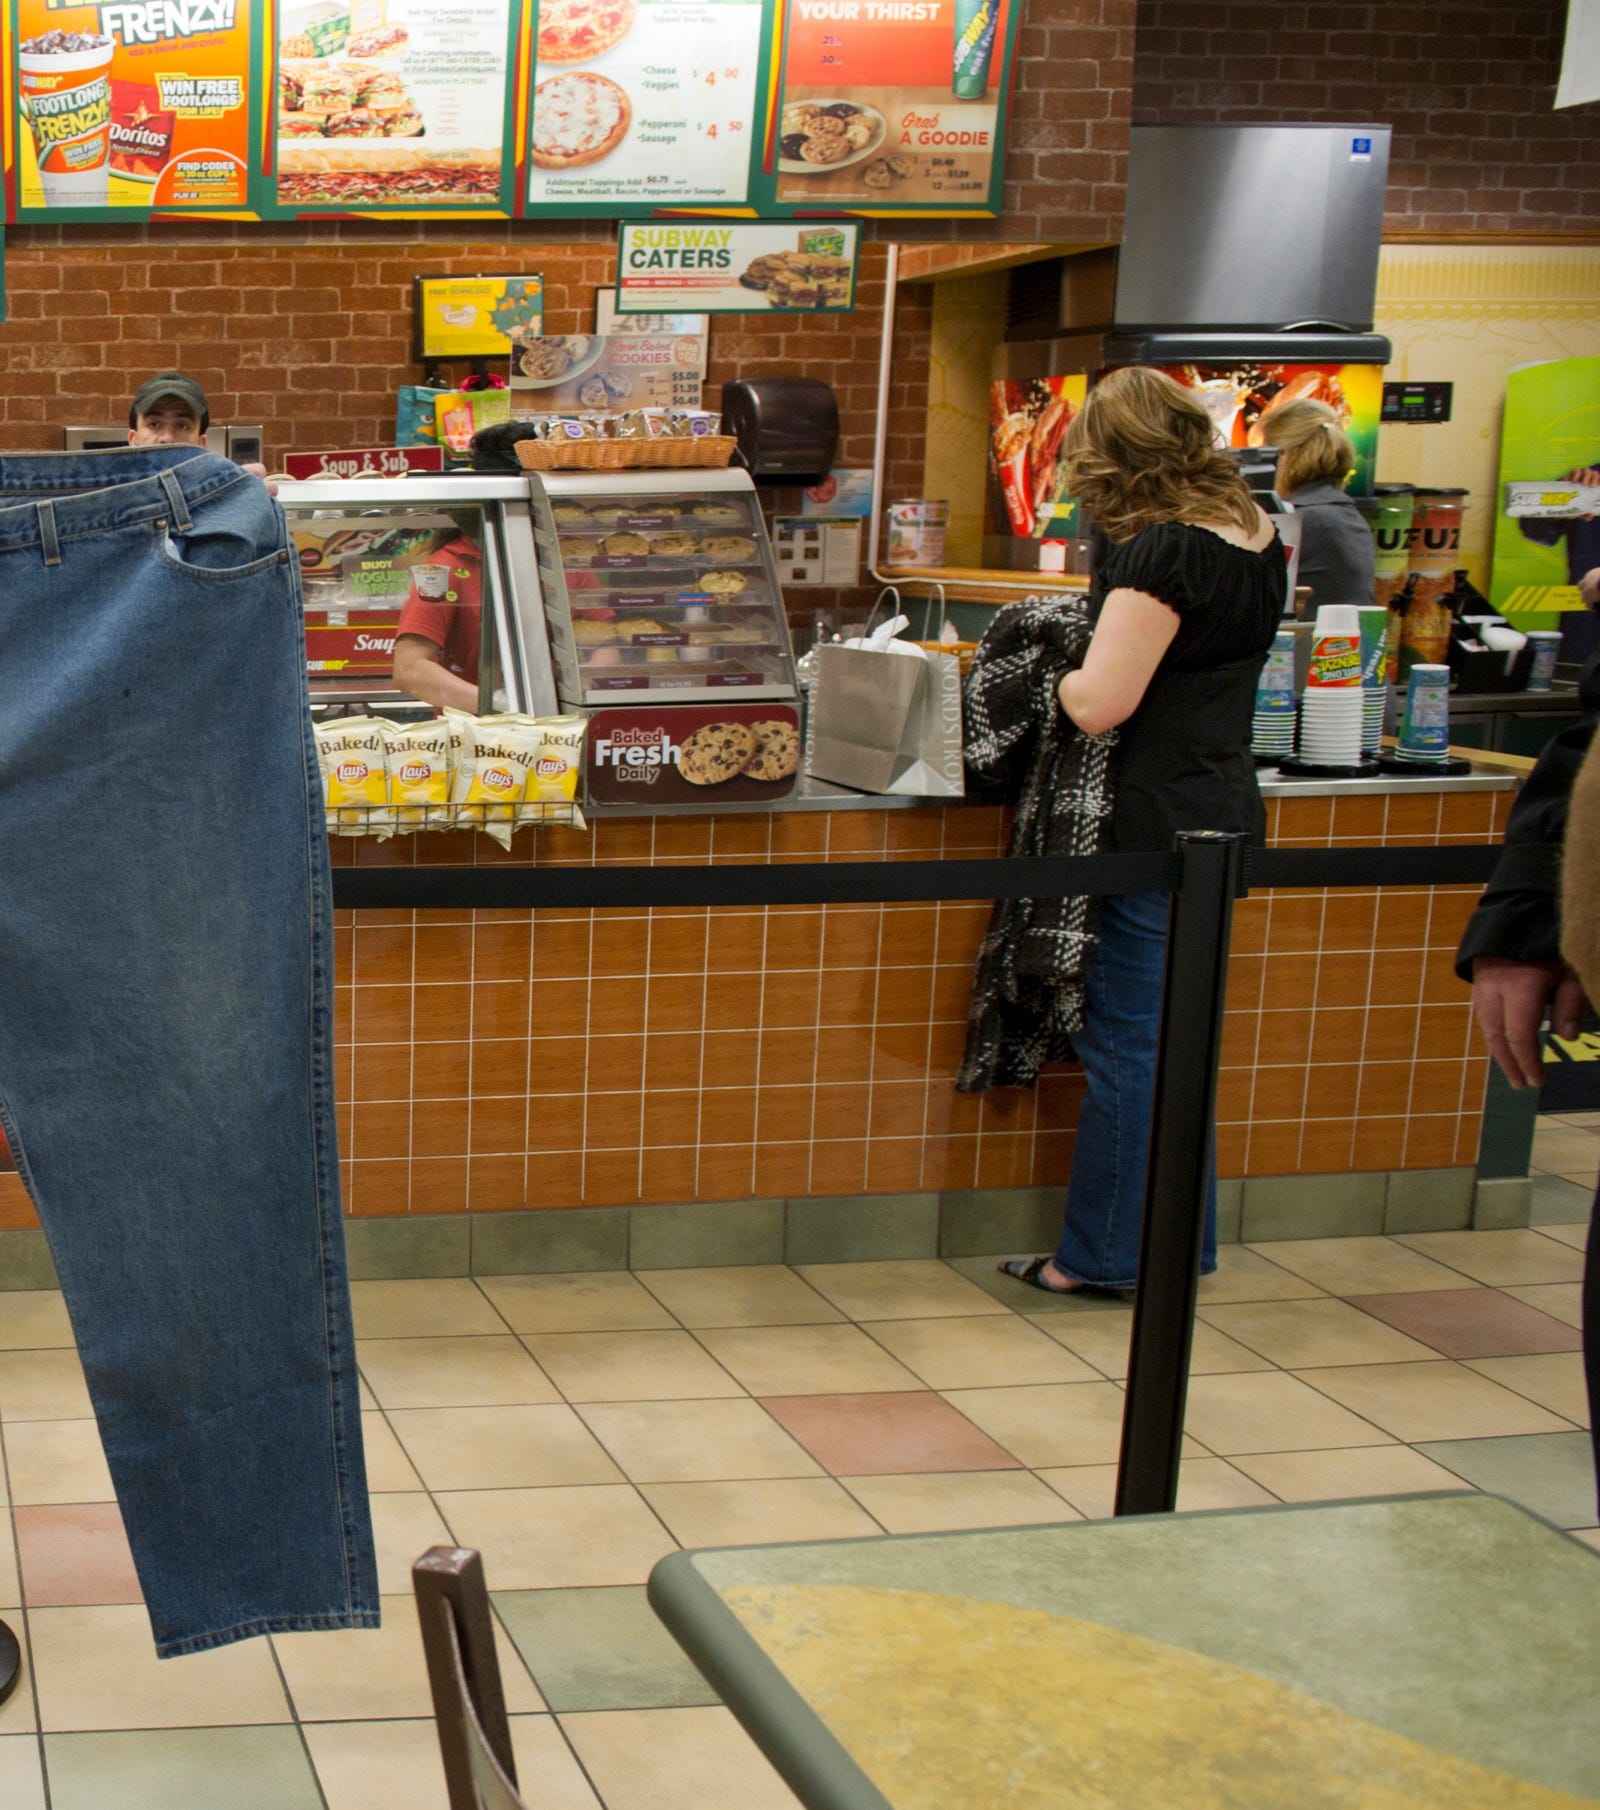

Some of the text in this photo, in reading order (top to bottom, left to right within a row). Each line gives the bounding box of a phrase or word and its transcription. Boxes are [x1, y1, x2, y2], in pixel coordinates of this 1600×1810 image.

[798, 3, 943, 21] YOUR THIRST
[100, 0, 236, 45] FRENZY!
[644, 80, 680, 91] Veggies
[705, 71, 717, 87] 4
[724, 68, 739, 79] 00
[160, 79, 239, 96] WIN FREE
[31, 80, 106, 116] FOOTLONG
[163, 94, 241, 107] FOOTLONGS
[36, 97, 109, 148] FRENZY!
[901, 111, 941, 129] Grab
[109, 122, 169, 148] Doritos
[641, 119, 743, 140] Pepperoni 4 50
[640, 135, 677, 144] Sausage
[900, 131, 989, 146] A GOODIE
[176, 161, 236, 171] FIND CODES
[588, 178, 625, 188] Toppings
[642, 187, 683, 196] Pepperoni
[694, 187, 726, 197] Sausage
[631, 229, 734, 249] SUBWAY
[629, 249, 732, 269] CATERS
[611, 352, 671, 365] COOKIES
[671, 371, 700, 381] $5.00
[672, 384, 699, 393] $1.39
[671, 396, 700, 405] $0.49
[319, 451, 409, 477] Soup & Sub
[1510, 492, 1580, 507] SUBWAY
[360, 560, 393, 570] ENJOY
[613, 728, 663, 744] Baked
[941, 659, 961, 796] NORDSTROM
[319, 735, 380, 756] Baked!
[384, 735, 444, 756] Baked!
[594, 735, 682, 767] Fresh
[474, 744, 533, 768] Baked!
[618, 766, 658, 783] Daily
